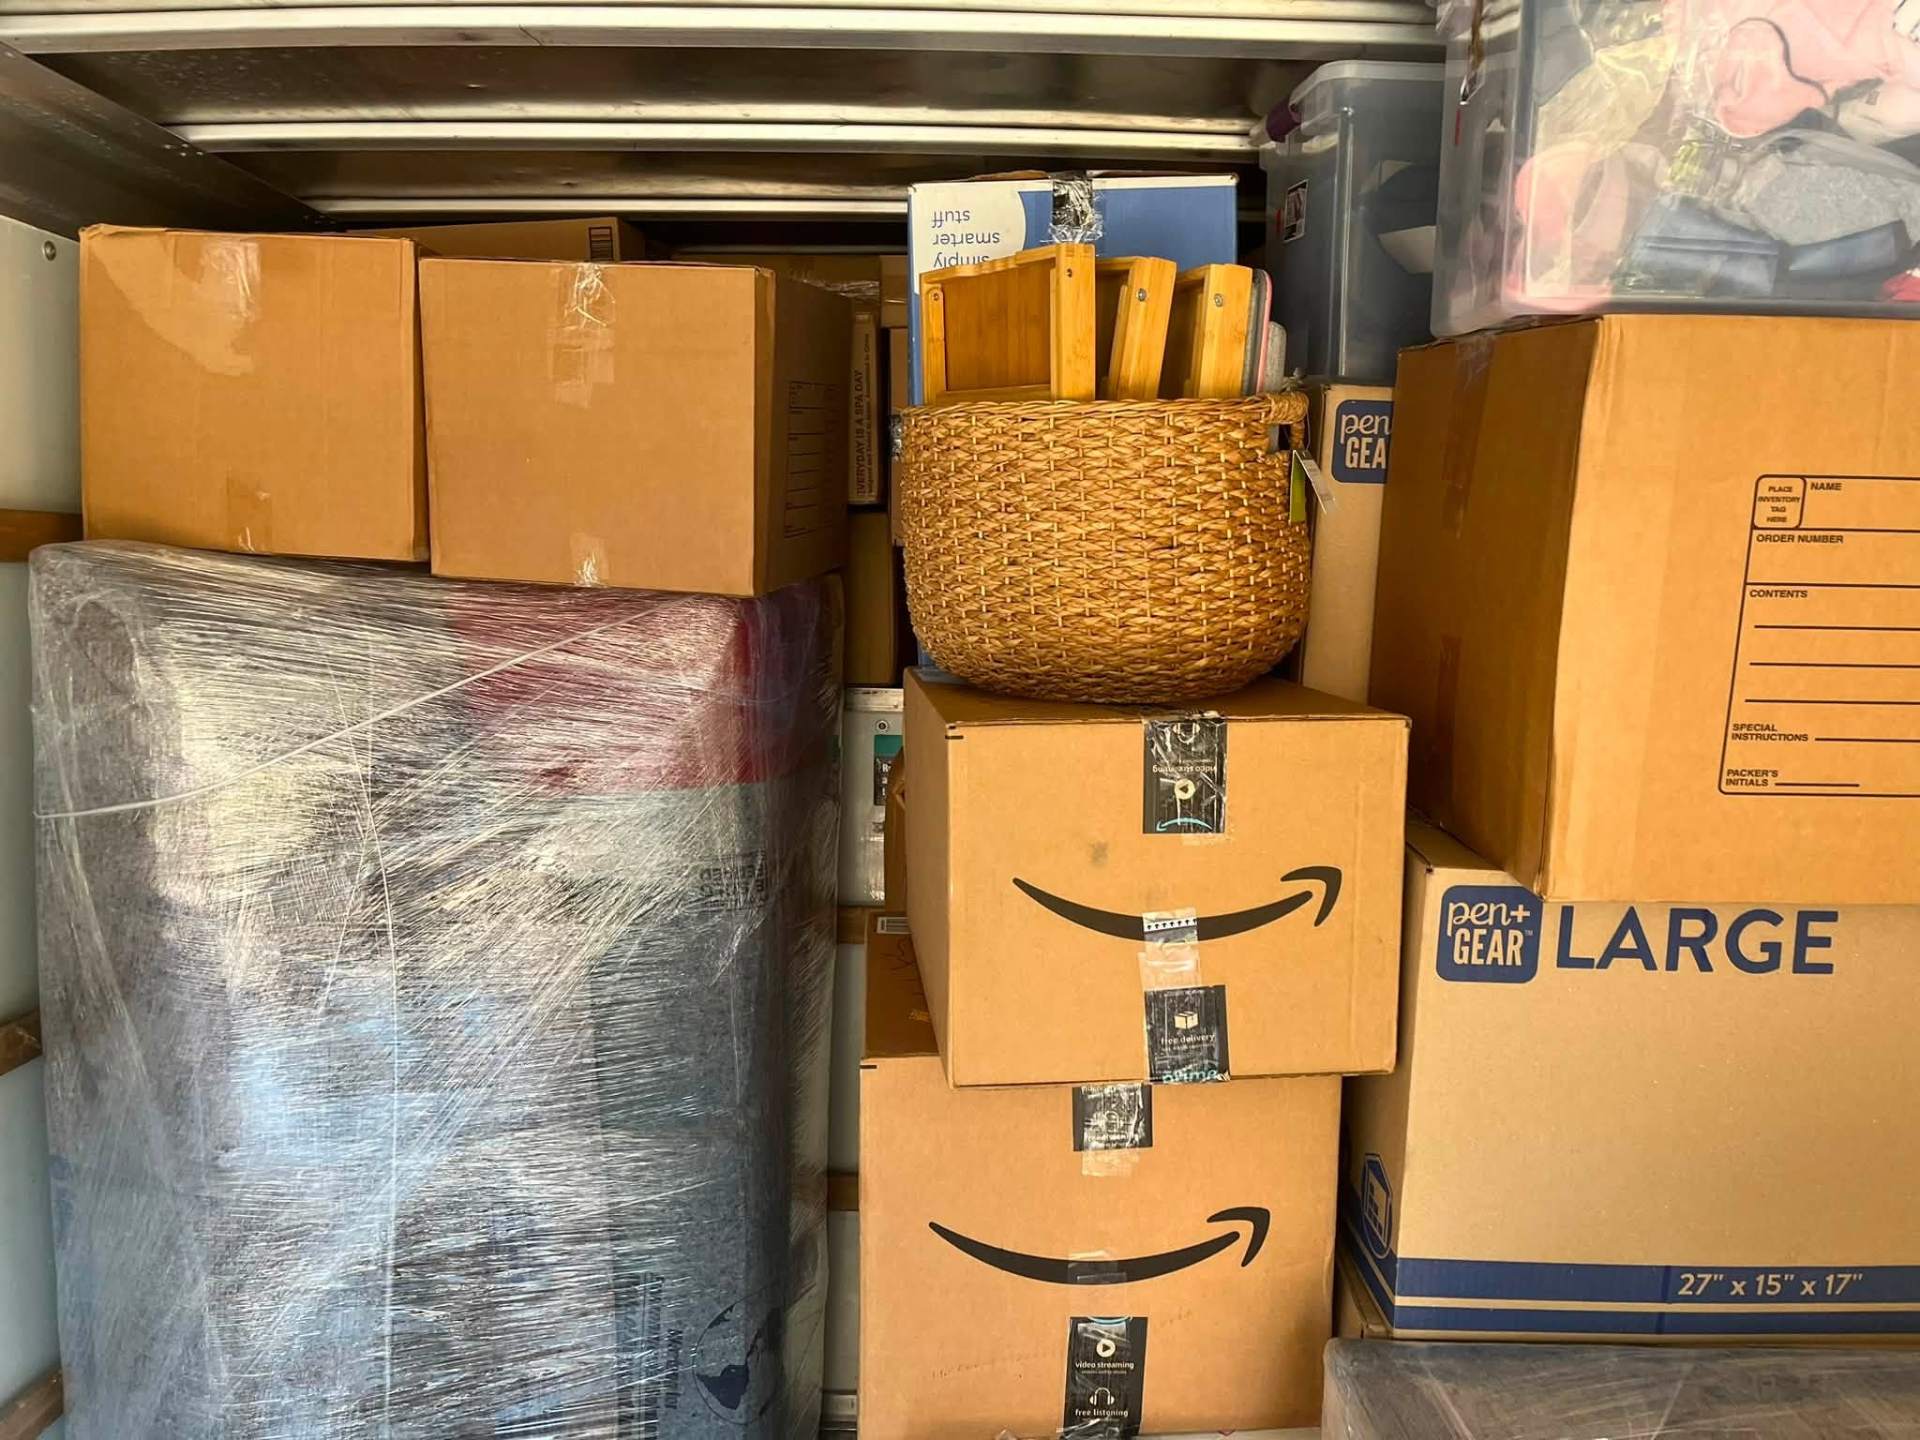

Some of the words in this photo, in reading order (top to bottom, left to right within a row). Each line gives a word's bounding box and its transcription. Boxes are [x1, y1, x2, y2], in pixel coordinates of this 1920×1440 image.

[931, 210, 971, 229] stuff
[932, 232, 1001, 247] smarter
[854, 370, 864, 392] DAY
[1340, 414, 1390, 444] pen
[1345, 436, 1386, 469] GEA
[1810, 482, 1842, 491] NAME
[1756, 534, 1795, 543] ORDER
[1797, 535, 1844, 544] NUMBER
[1749, 589, 1808, 598] CONTENTS
[1732, 723, 1778, 732] SPECIAL
[1731, 732, 1809, 742] INSTRUCTIONS
[1726, 769, 1778, 778] PACKER'S
[1725, 778, 1769, 787] INITIALS
[1446, 900, 1531, 938] pen+
[1556, 904, 1839, 975] LARGE
[1452, 927, 1524, 967] GEAR
[1677, 1273, 1724, 1296] 27"
[1730, 1280, 1748, 1296] x
[1755, 1273, 1795, 1296] 15"
[1800, 1280, 1817, 1296] x
[1824, 1272, 1864, 1296] 17"
[1075, 1361, 1096, 1369] video
[1097, 1361, 1134, 1370] streaming
[1075, 1408, 1091, 1417] free
